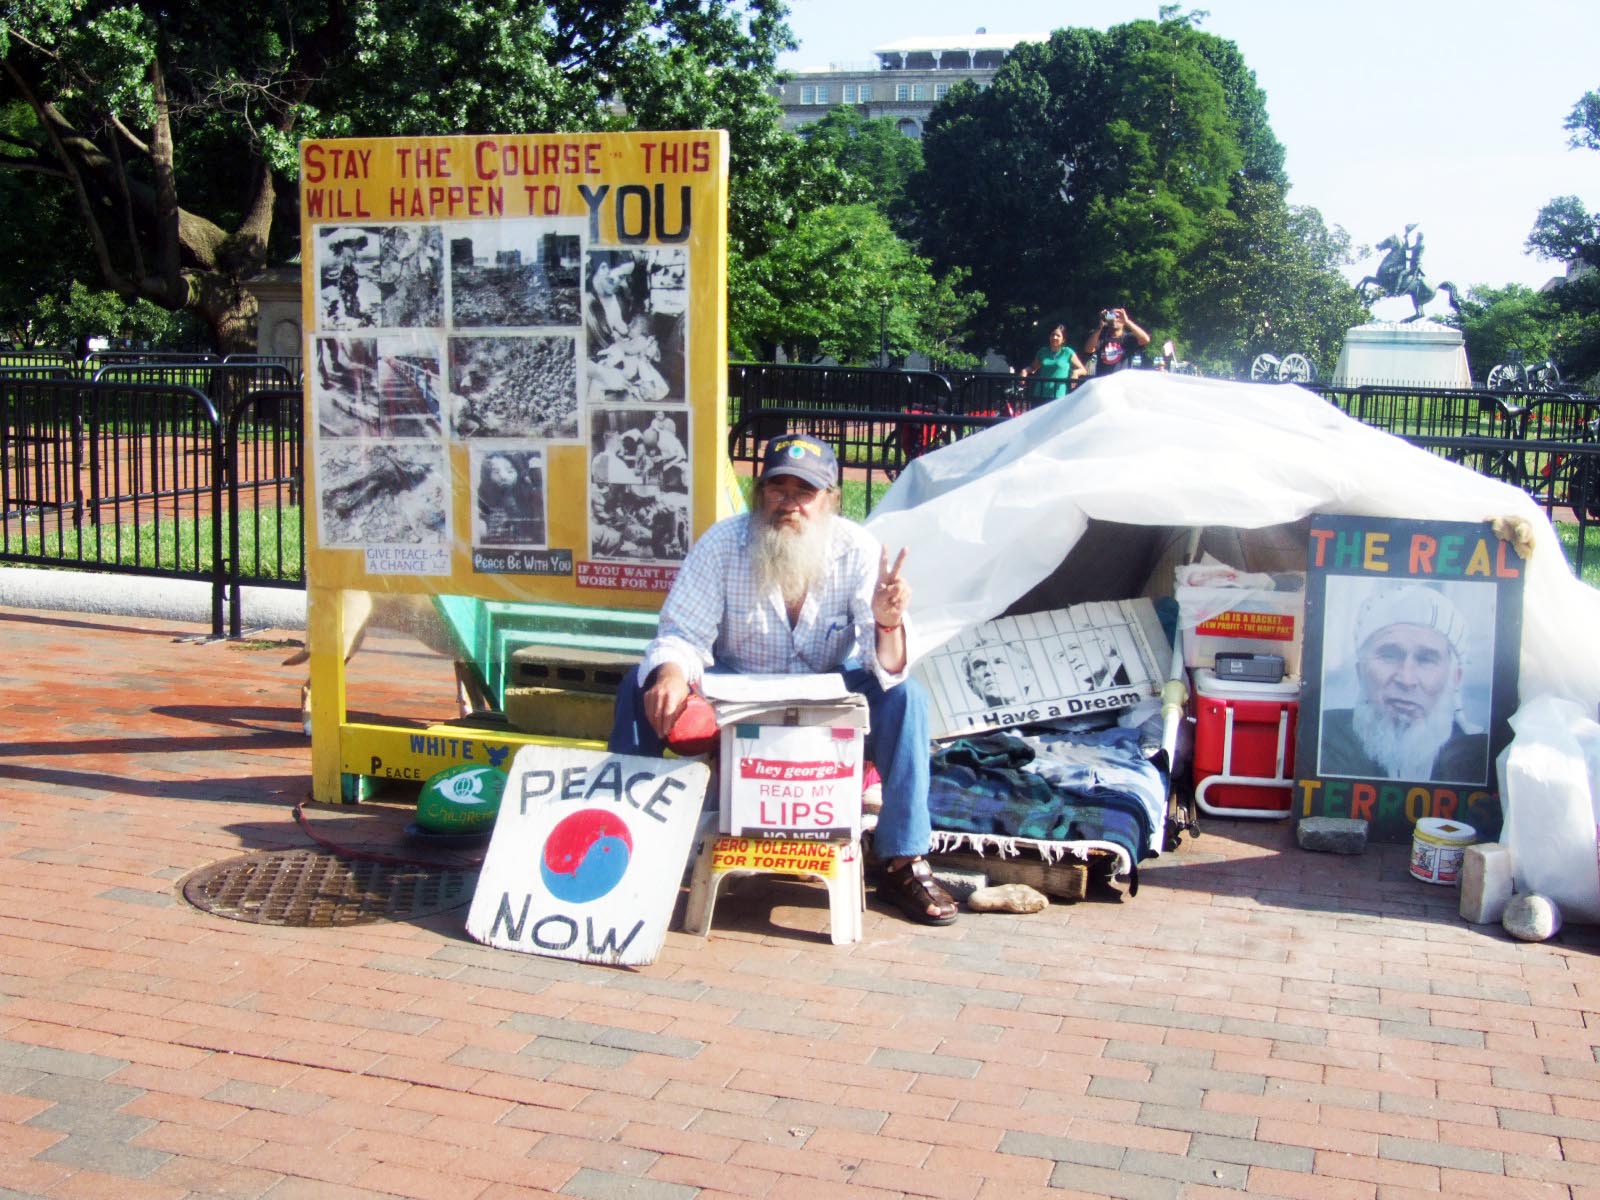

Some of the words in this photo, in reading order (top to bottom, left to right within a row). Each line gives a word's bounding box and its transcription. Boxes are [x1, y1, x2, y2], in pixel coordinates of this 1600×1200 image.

[305, 144, 371, 183] STAY
[397, 148, 452, 179] THE
[475, 140, 601, 180] COURSE
[640, 141, 710, 174] THIS
[306, 188, 371, 218] WILL
[390, 186, 504, 216] HAPPEN
[524, 185, 560, 216] TO
[577, 183, 692, 245] YOU
[367, 548, 391, 559] GIVE
[395, 548, 428, 560] PEACE
[523, 555, 549, 572] WITH
[550, 556, 572, 572] YOU
[1310, 528, 1390, 572] THE
[1409, 533, 1520, 578] REAL
[369, 560, 377, 570] A
[380, 560, 426, 571] CHANCE
[577, 564, 590, 575] IF
[594, 565, 620, 576] YOU
[623, 567, 660, 578] WANT
[578, 575, 617, 587] WORK
[620, 577, 648, 588] FOR
[967, 716, 975, 729] I
[983, 708, 1040, 727] Have
[1048, 705, 1062, 718] a
[1067, 692, 1142, 714] Dream
[410, 734, 474, 760] WHITE
[371, 756, 421, 779] PEACE
[755, 762, 782, 778] hey
[520, 761, 687, 824] PEACE
[760, 784, 804, 798] READ
[812, 785, 834, 798] MY
[760, 801, 834, 826] LIPS
[712, 837, 748, 853] ZERO
[753, 839, 836, 858] TOLERANCE
[712, 854, 747, 866] FOR
[752, 856, 831, 871] TORTURE
[490, 893, 645, 956] NOW
